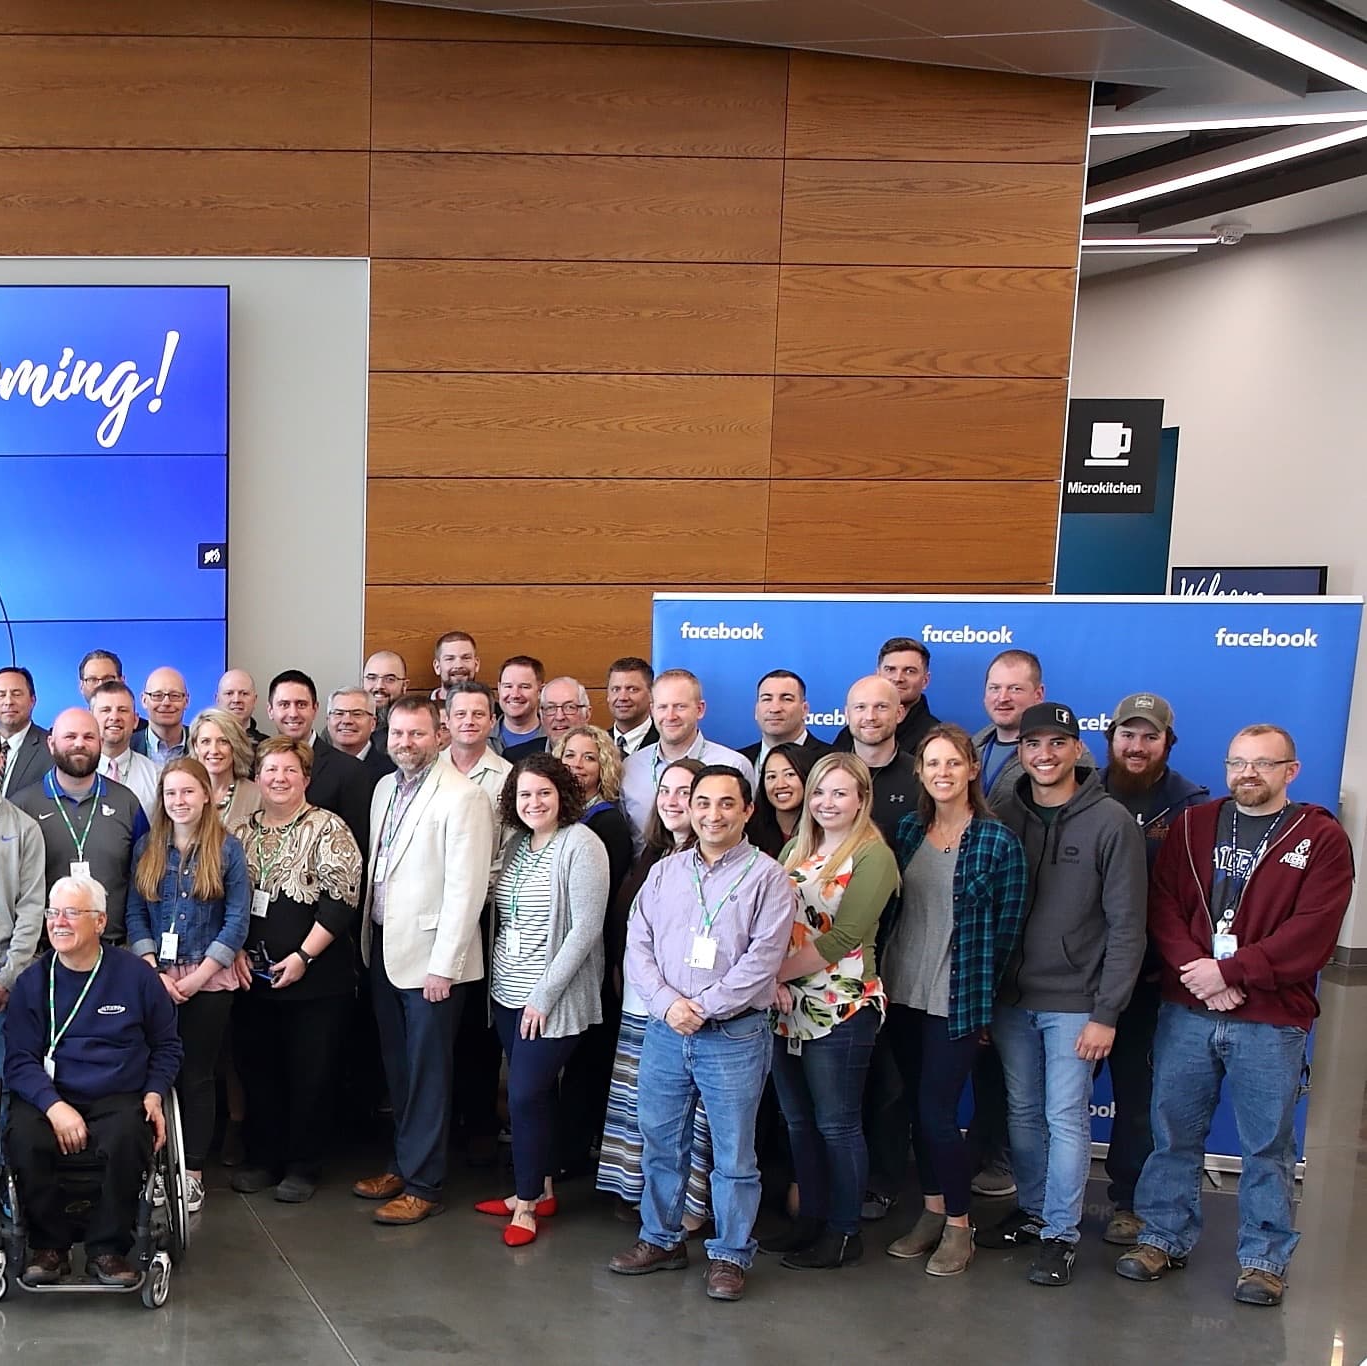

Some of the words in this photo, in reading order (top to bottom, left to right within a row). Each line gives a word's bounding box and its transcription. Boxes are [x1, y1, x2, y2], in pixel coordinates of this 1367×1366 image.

[1067, 481, 1142, 494] Microkitchen
[680, 621, 764, 640] facebook
[921, 624, 1013, 643] facebook
[1215, 627, 1319, 647] facebook
[804, 708, 845, 726] aceb
